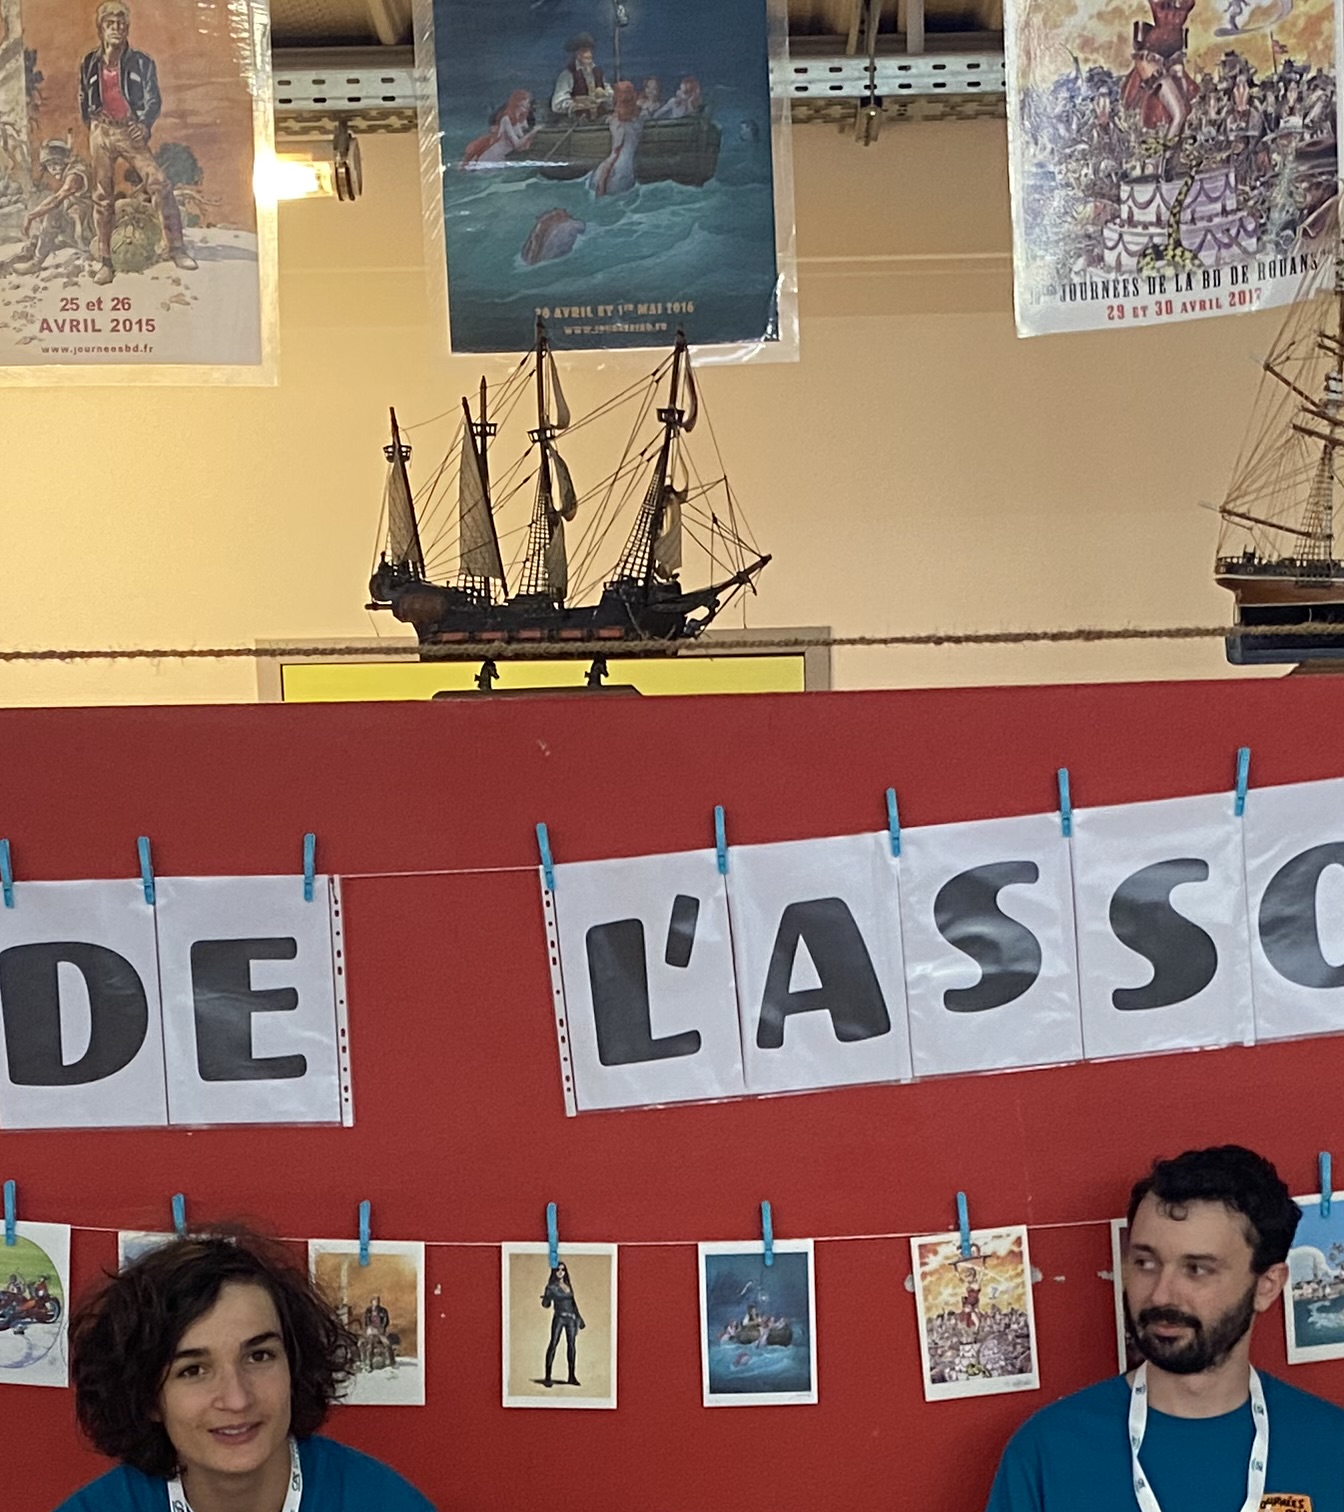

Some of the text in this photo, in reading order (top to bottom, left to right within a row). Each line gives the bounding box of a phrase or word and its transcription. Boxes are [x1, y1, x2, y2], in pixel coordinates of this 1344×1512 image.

[1148, 254, 1319, 296] DE LA BD DE ROUANS
[59, 297, 132, 312] 25 et 26
[554, 301, 695, 319] AVRIL ET MAI 2016
[1107, 298, 1223, 320] 29 ET 30 AVRIL
[39, 318, 156, 334] AVRIL 2015
